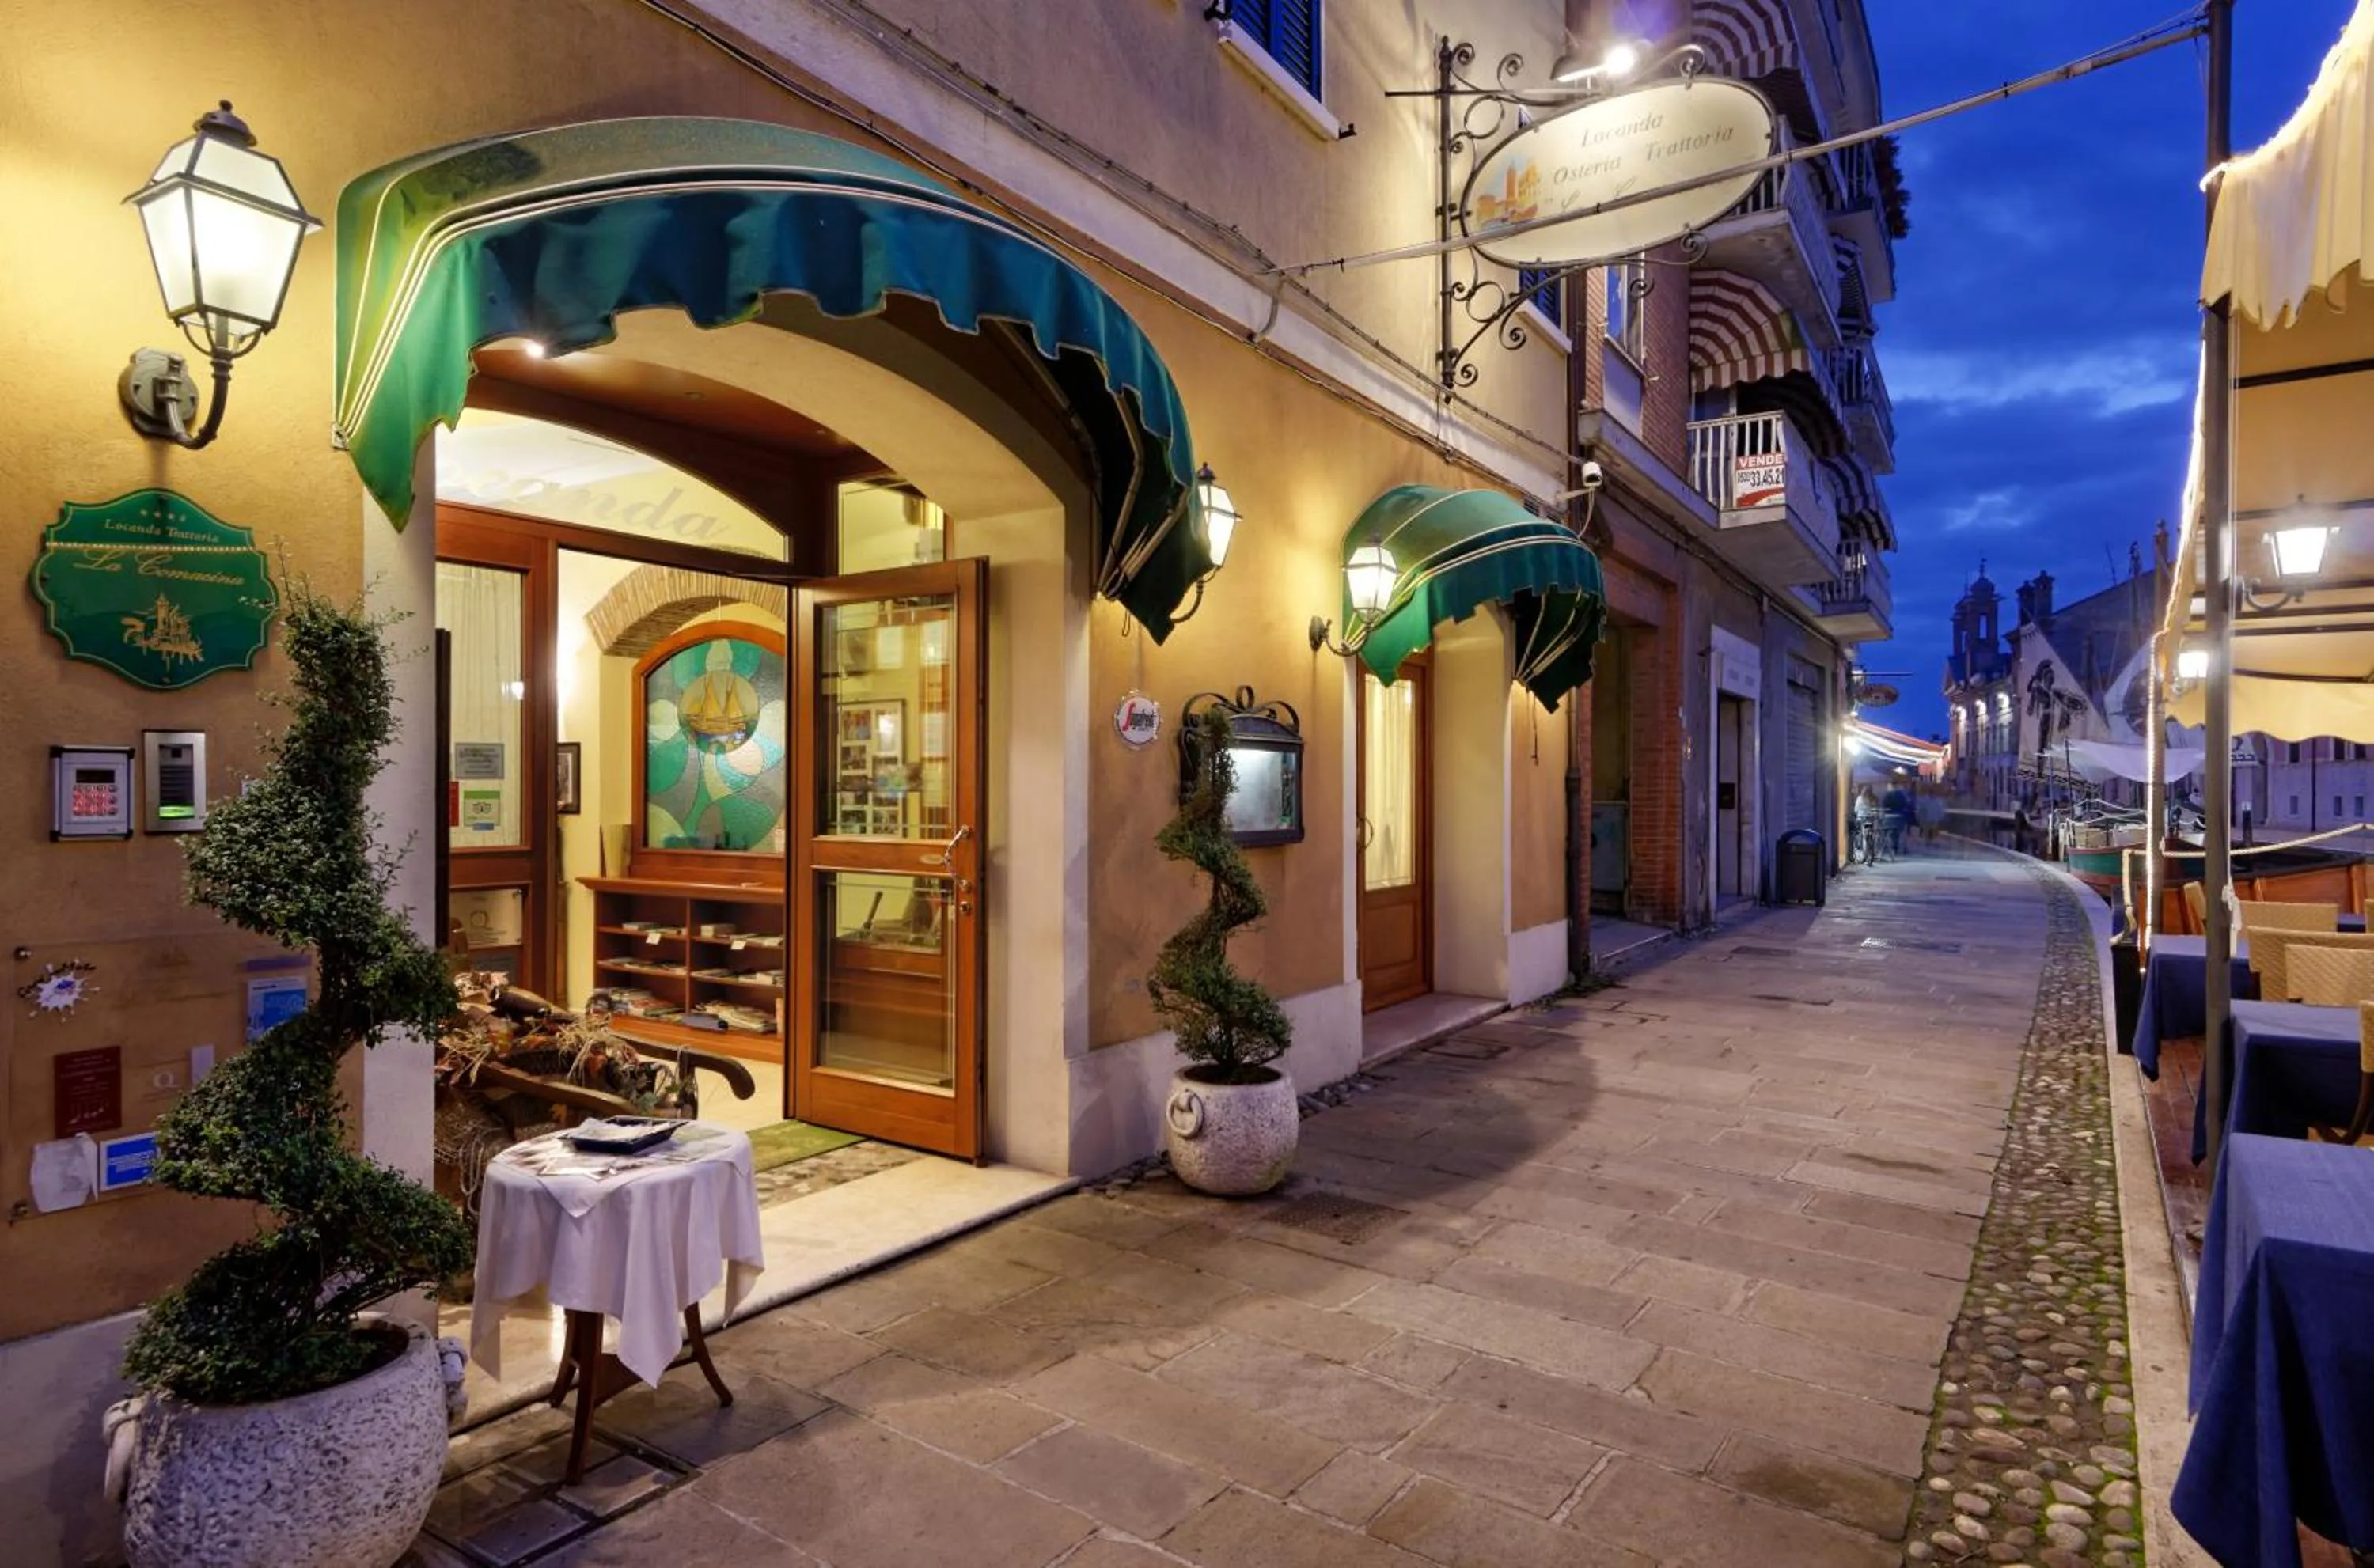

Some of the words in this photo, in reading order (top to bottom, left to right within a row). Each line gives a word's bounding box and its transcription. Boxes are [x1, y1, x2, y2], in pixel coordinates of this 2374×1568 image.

[1581, 112, 1663, 148] Locanda
[1553, 155, 1622, 185] Osteria
[1646, 125, 1734, 161] Trattoria
[1738, 453, 1784, 468] VENDE
[104, 518, 161, 536] Locanda
[166, 525, 220, 543] Trattoria
[74, 549, 123, 572] La
